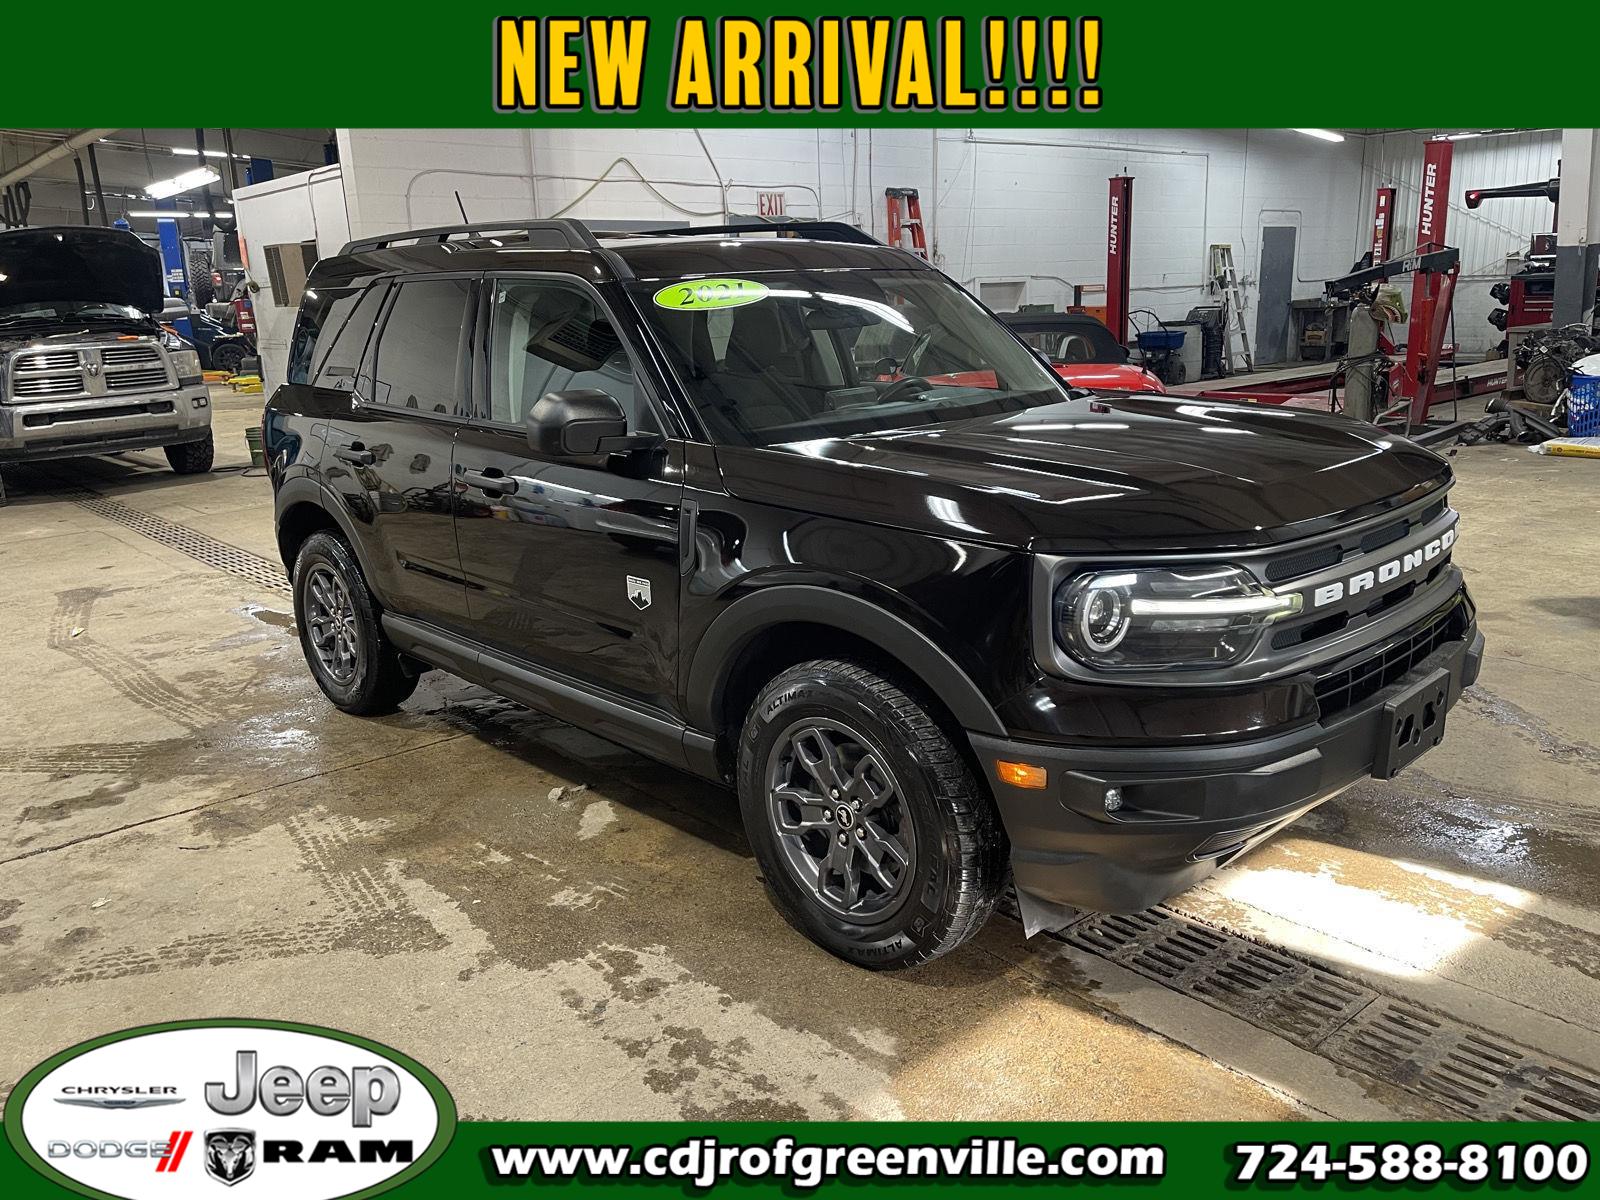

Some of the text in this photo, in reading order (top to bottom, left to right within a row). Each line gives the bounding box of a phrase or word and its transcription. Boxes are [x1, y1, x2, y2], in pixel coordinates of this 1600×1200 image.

[760, 193, 784, 216] EXIT
[1109, 196, 1119, 255] HUNTER
[1421, 163, 1437, 235] HUNTER
[678, 282, 744, 305] 2021
[1314, 529, 1454, 607] BRONCO
